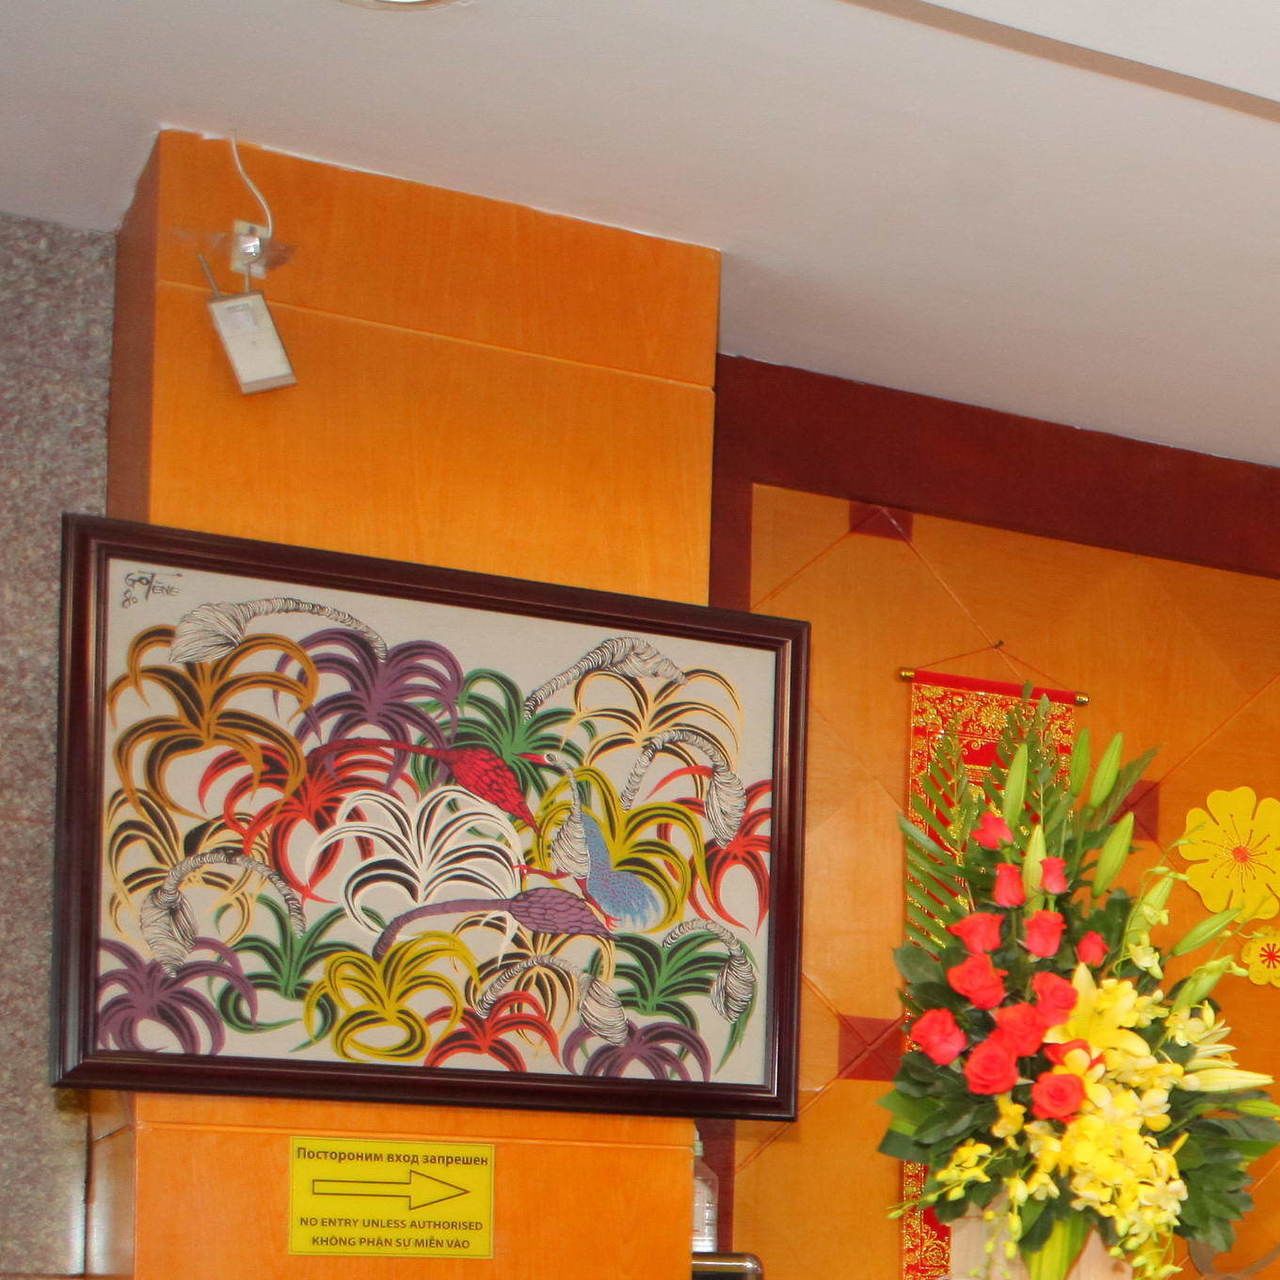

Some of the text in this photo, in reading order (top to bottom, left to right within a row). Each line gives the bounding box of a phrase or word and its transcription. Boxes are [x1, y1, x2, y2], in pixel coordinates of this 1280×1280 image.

[386, 1153, 420, 1166] вход
[299, 1216, 484, 1231] NO ENTRY UNLESS AUTHORISED
